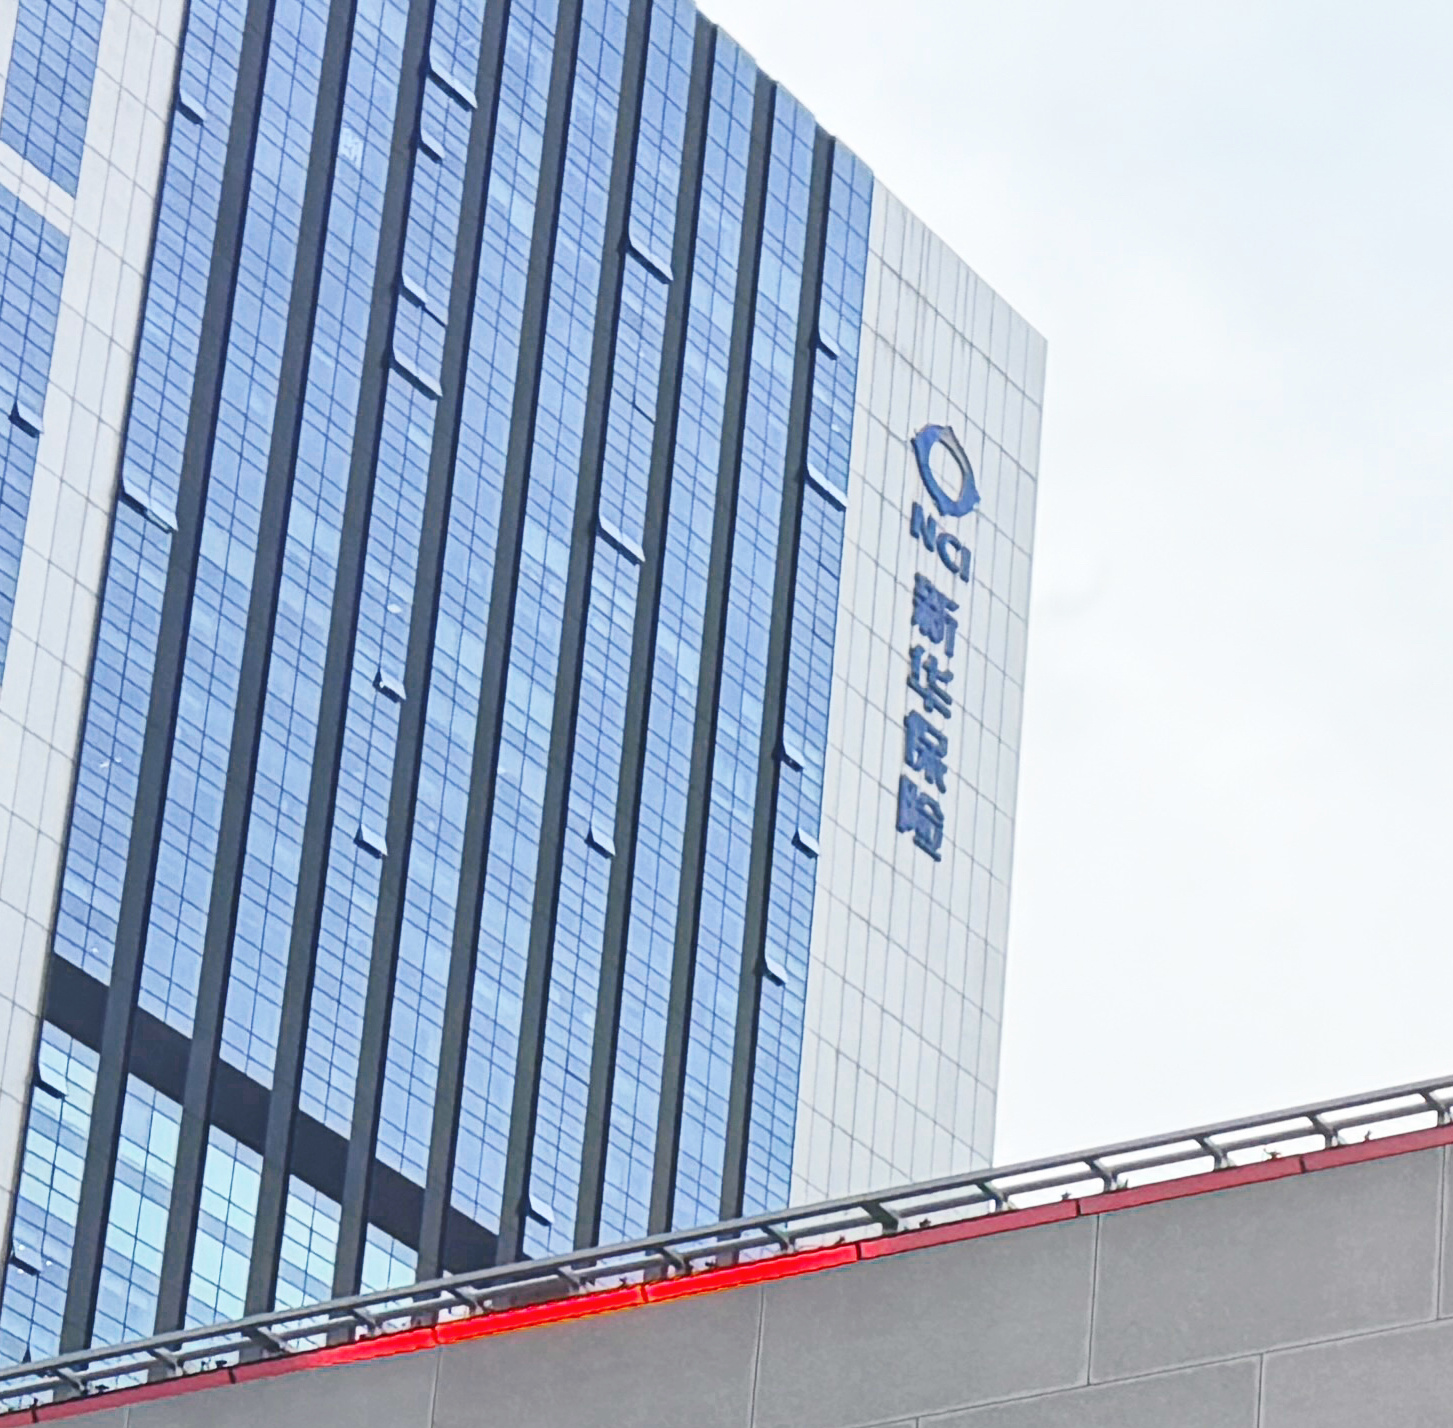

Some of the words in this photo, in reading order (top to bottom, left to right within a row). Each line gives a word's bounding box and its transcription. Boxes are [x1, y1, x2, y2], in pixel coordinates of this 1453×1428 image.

[910, 501, 971, 583] NCI
[896, 572, 959, 862] 新华保险
